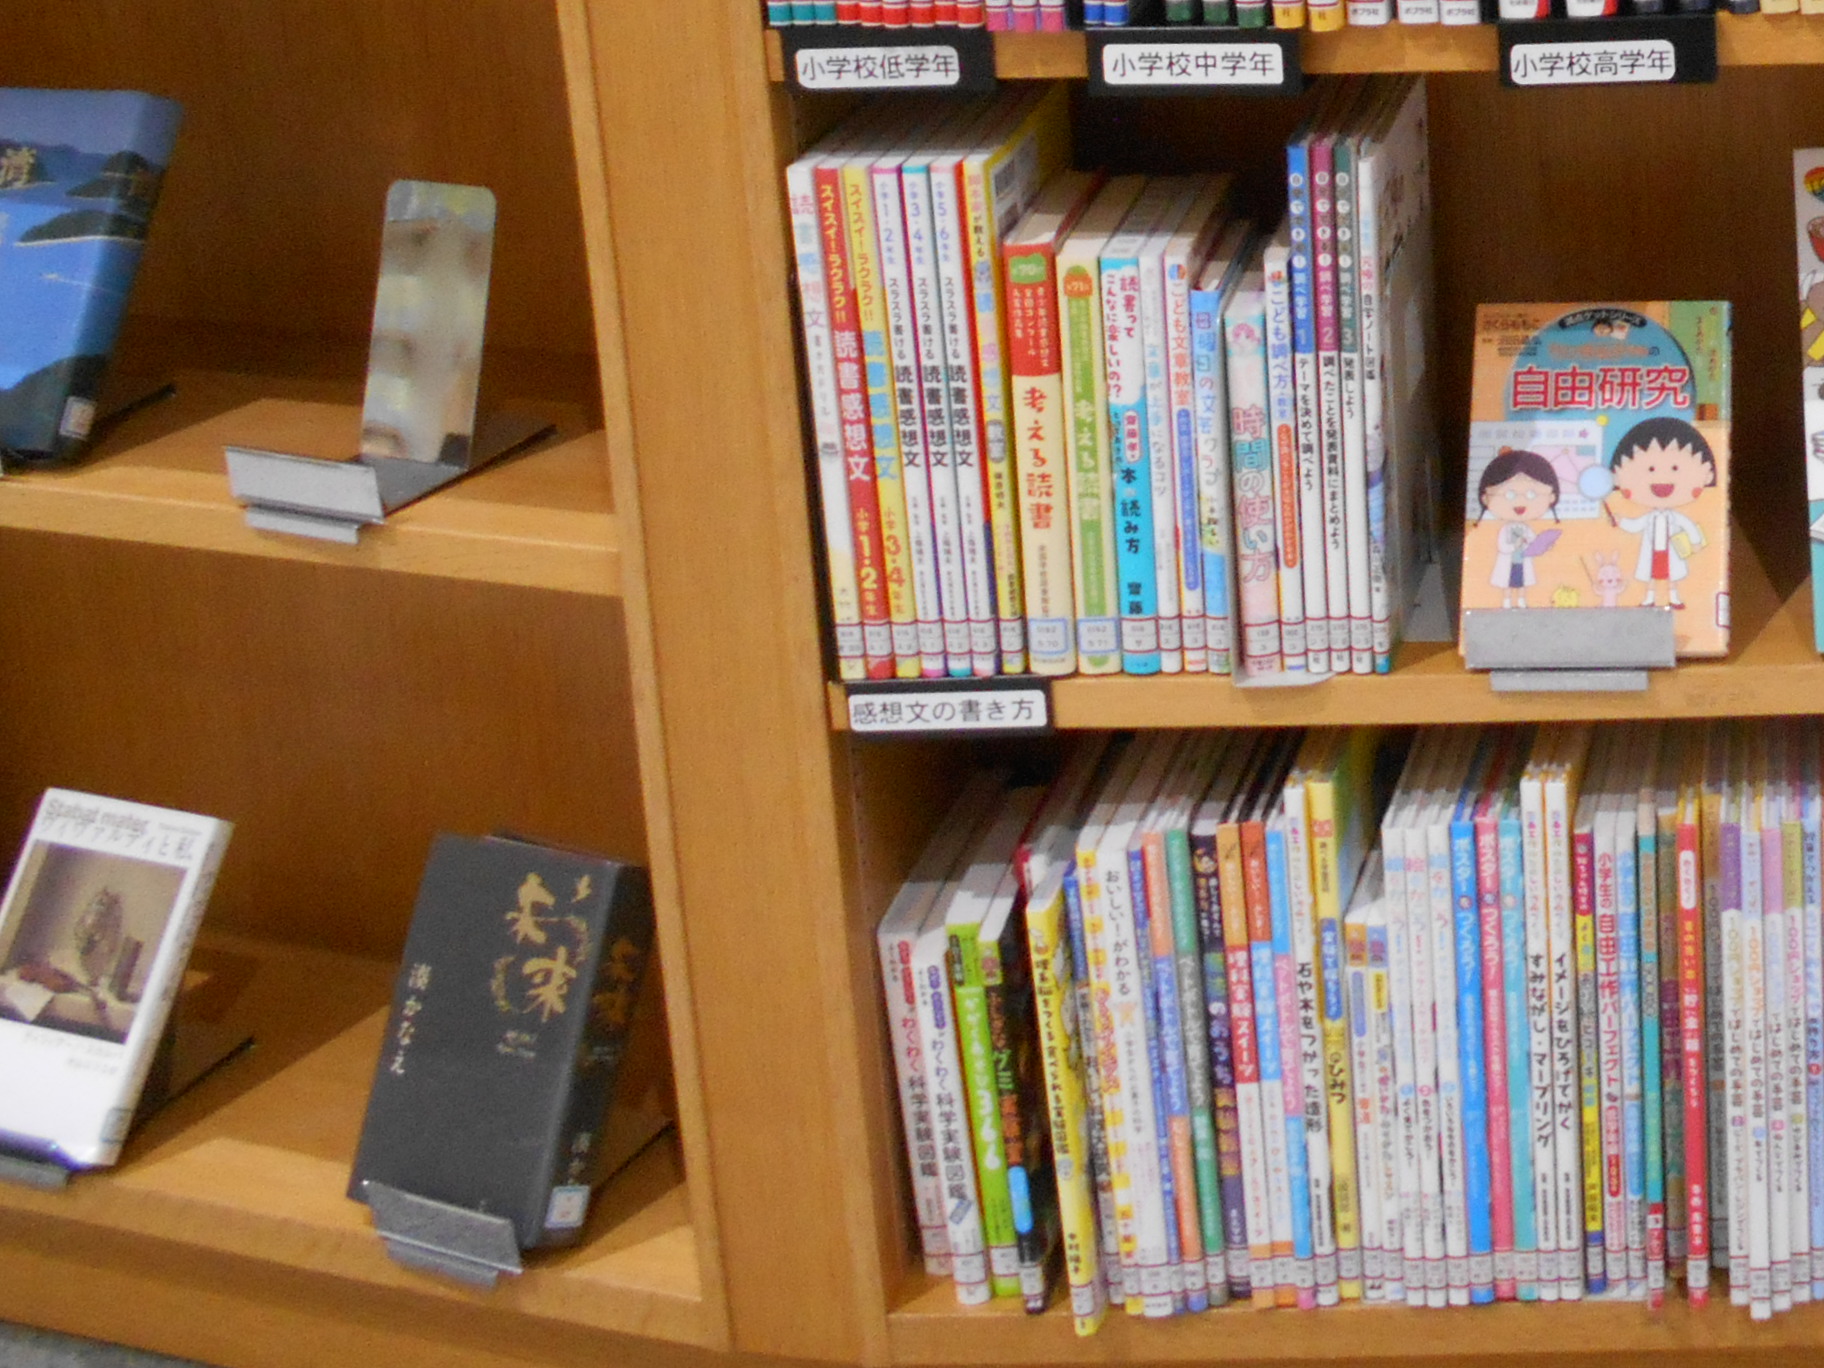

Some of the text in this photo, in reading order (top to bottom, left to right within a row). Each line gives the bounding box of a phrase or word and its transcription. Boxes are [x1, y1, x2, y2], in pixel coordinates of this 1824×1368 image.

[801, 53, 958, 82] 小学校低学年
[1111, 52, 1277, 79] 小学校中学年
[1513, 48, 1675, 81] 小学校高学年
[1119, 274, 1141, 339] 読書って
[832, 329, 872, 482] 読書感想文
[894, 364, 921, 469] 読書感想文
[922, 364, 949, 469] 読書感想文
[948, 364, 974, 469] 読書感想文
[1512, 363, 1692, 412] 自由研究
[1021, 386, 1053, 530] 考える読書
[1231, 408, 1278, 585] 時間の使い方
[853, 697, 1035, 726] 感想文の書き方
